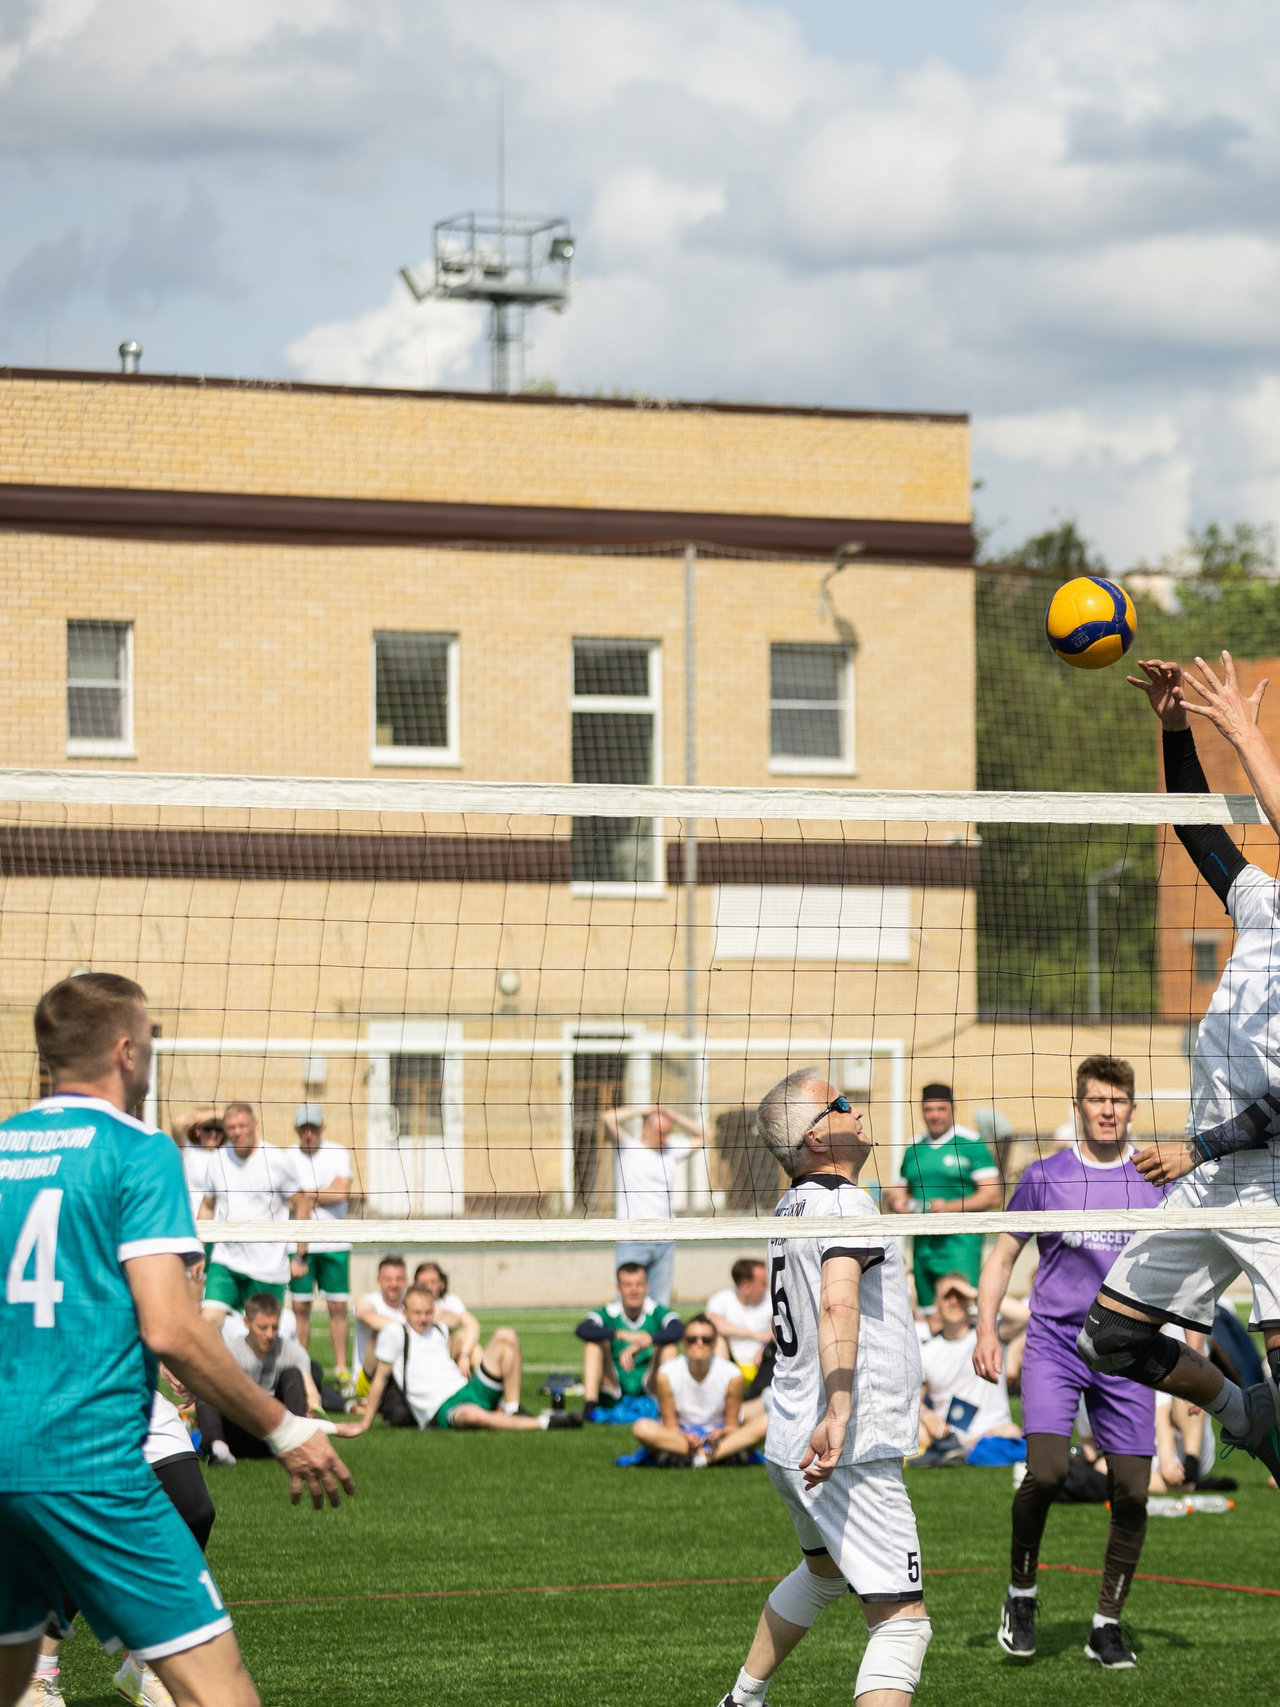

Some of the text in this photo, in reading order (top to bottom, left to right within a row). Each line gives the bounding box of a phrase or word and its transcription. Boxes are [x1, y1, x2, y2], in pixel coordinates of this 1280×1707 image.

[0, 1124, 98, 1154] ОЛОГОДСКИЙ
[0, 1187, 64, 1329] 4
[1083, 1240, 1124, 1252] СЕВЕРО-ЗА
[770, 1255, 798, 1358] 5
[907, 1551, 919, 1584] 5
